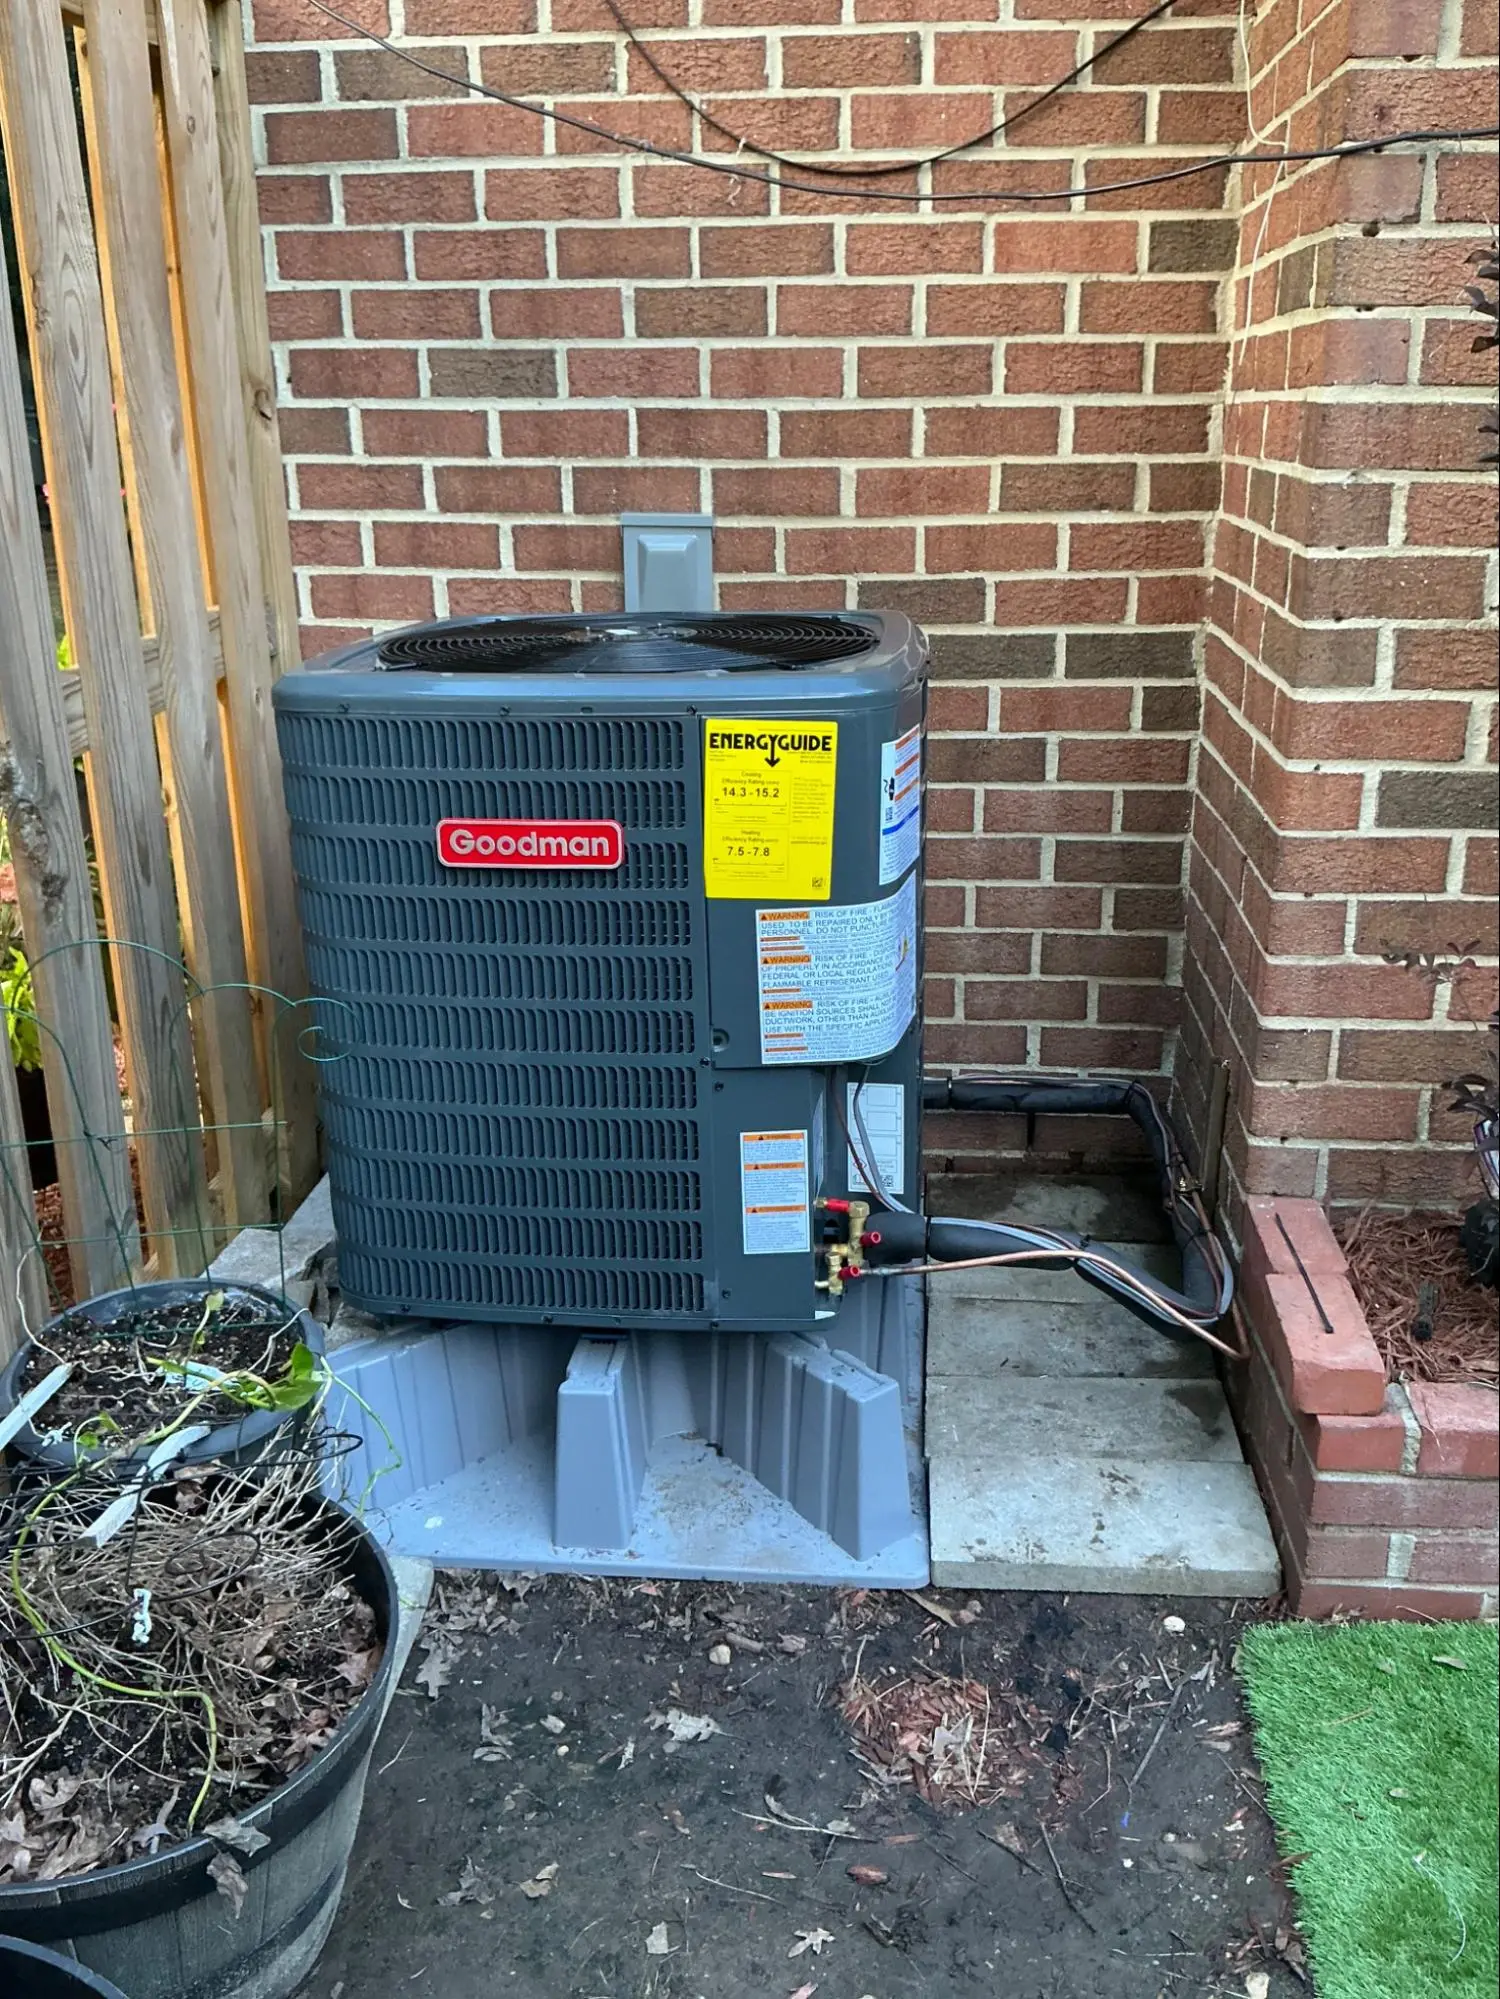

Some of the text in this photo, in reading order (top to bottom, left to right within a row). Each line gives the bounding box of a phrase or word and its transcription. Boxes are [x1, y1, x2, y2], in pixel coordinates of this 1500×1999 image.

[709, 733, 832, 751] ENERGYGUIDE
[722, 787, 746, 797] 14.3
[756, 788, 780, 798] 15.2
[449, 828, 609, 857] Goodman
[727, 846, 745, 856] 7.5
[753, 847, 770, 857] 7.8
[768, 912, 808, 920] WARNING
[850, 908, 867, 916] FIRE
[815, 918, 858, 927] REPAIRED
[859, 915, 878, 923] ONLY
[770, 955, 810, 963] WARNING
[775, 963, 819, 971] PROPERLY
[832, 957, 882, 969] ACCORDANCE
[803, 970, 816, 978] OR
[817, 970, 844, 978] LOCAL
[763, 980, 812, 988] FLAMMABLE
[814, 976, 870, 986] REFRIGERANT
[772, 1001, 811, 1009] WARNING
[778, 1009, 814, 1017] IGNITION
[816, 1007, 855, 1015] SOURCES
[858, 1004, 879, 1013] SHALL
[817, 1015, 846, 1023] OTHER
[848, 1013, 869, 1021] THAN
[765, 1026, 782, 1034] USE
[785, 1025, 805, 1033] WITH
[825, 1022, 862, 1031] SPECIFIC
